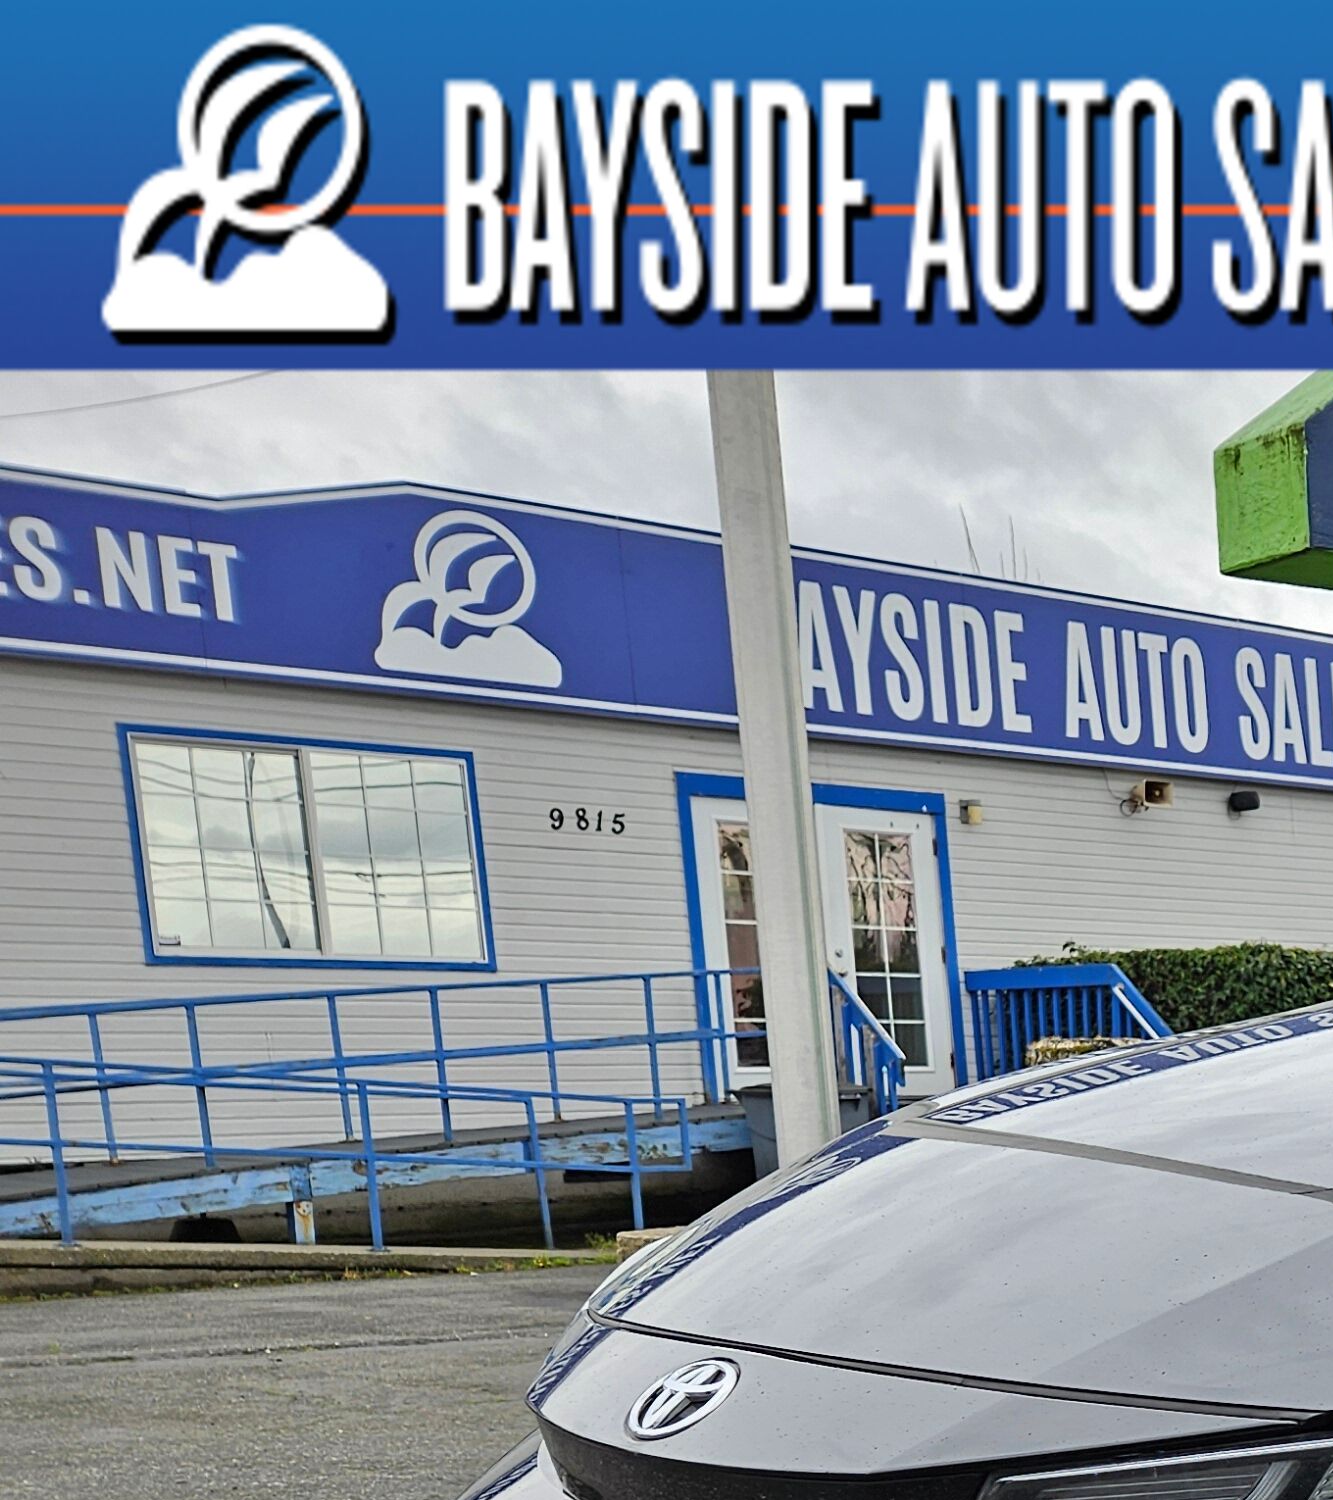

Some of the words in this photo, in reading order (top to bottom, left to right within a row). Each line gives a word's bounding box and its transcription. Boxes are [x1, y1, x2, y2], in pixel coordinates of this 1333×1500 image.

[0, 514, 240, 623] S.NET
[799, 579, 1033, 733] AYSIDE
[1065, 620, 1210, 754] AUTO
[549, 807, 626, 835] 9815
